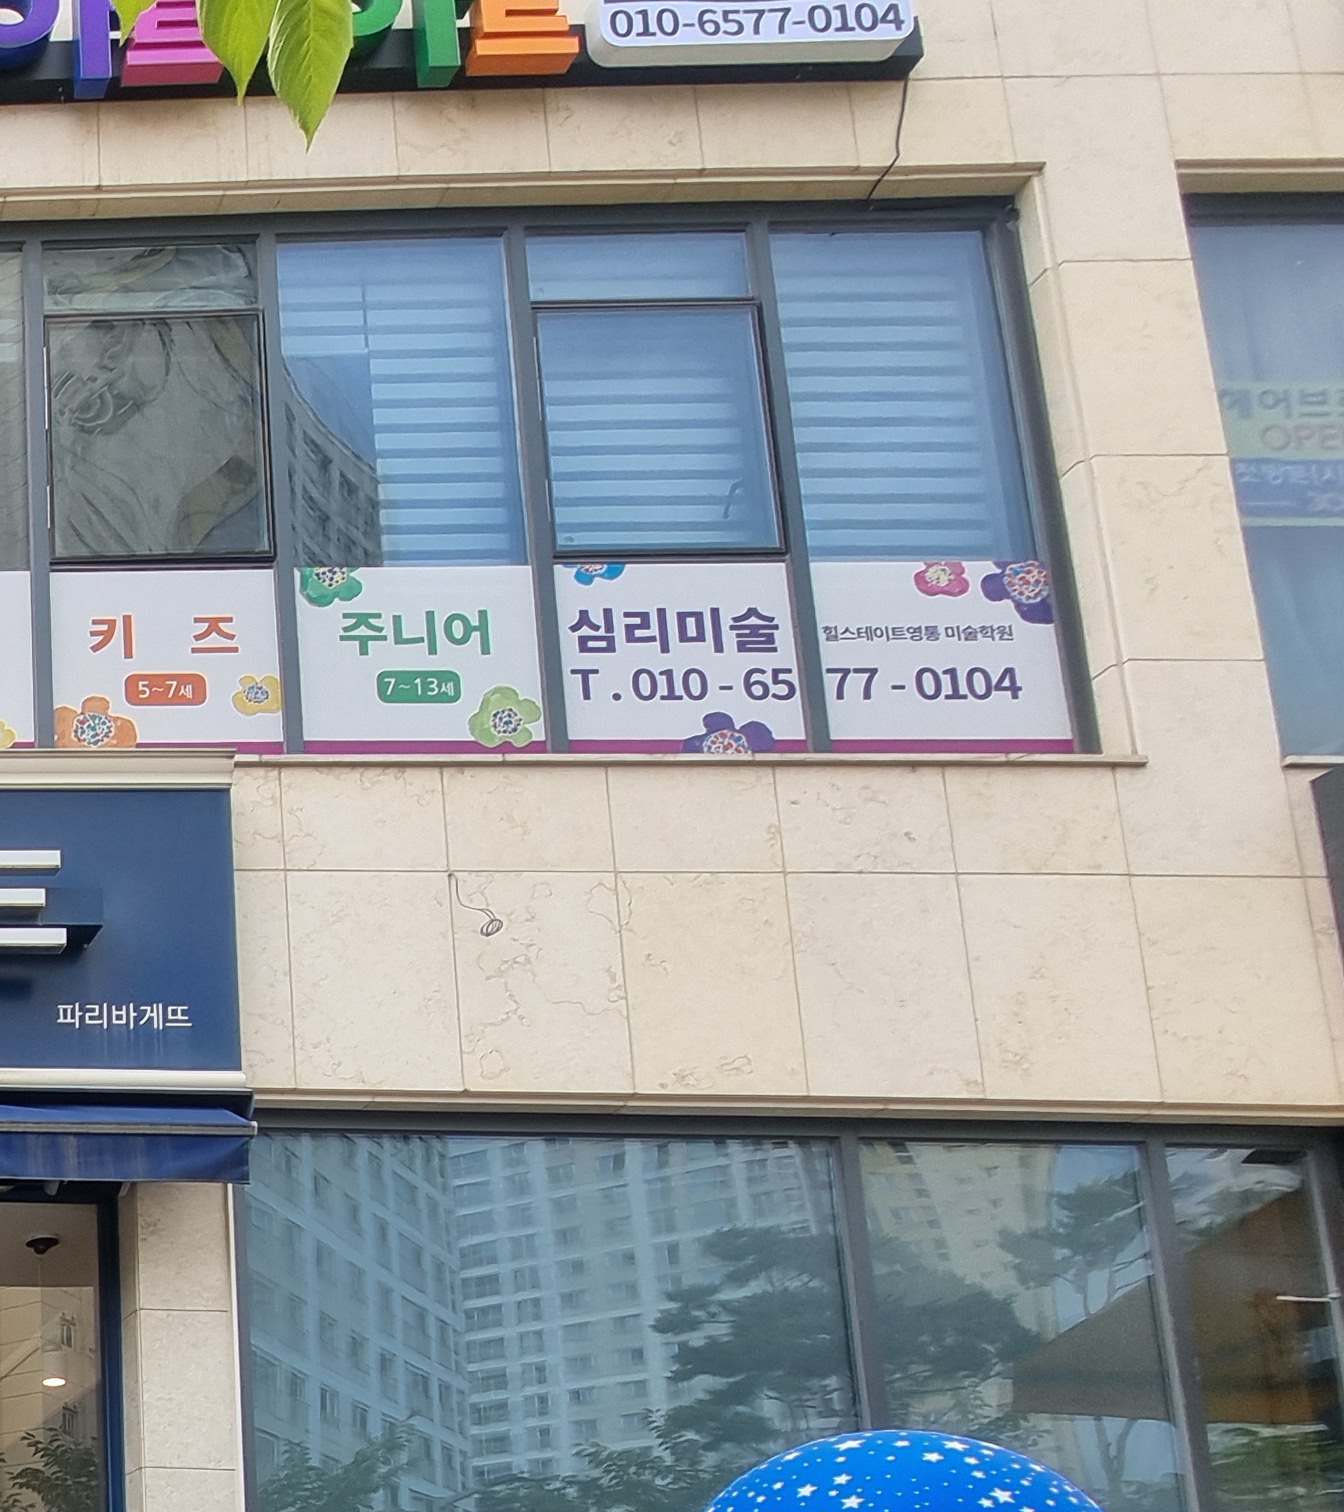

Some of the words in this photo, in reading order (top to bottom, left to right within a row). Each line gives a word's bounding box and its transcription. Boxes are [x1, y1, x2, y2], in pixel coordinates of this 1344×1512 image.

[610, 3, 905, 38] 010-6577-0104
[339, 609, 491, 656] 주니어
[568, 608, 779, 654] 심리미술
[822, 625, 940, 642] 힐스테이트영통
[944, 625, 1015, 642] 미술학원
[137, 680, 194, 700] 5~7세
[383, 677, 455, 698] 7~13세
[55, 1002, 193, 1031] 파리바게뜨
